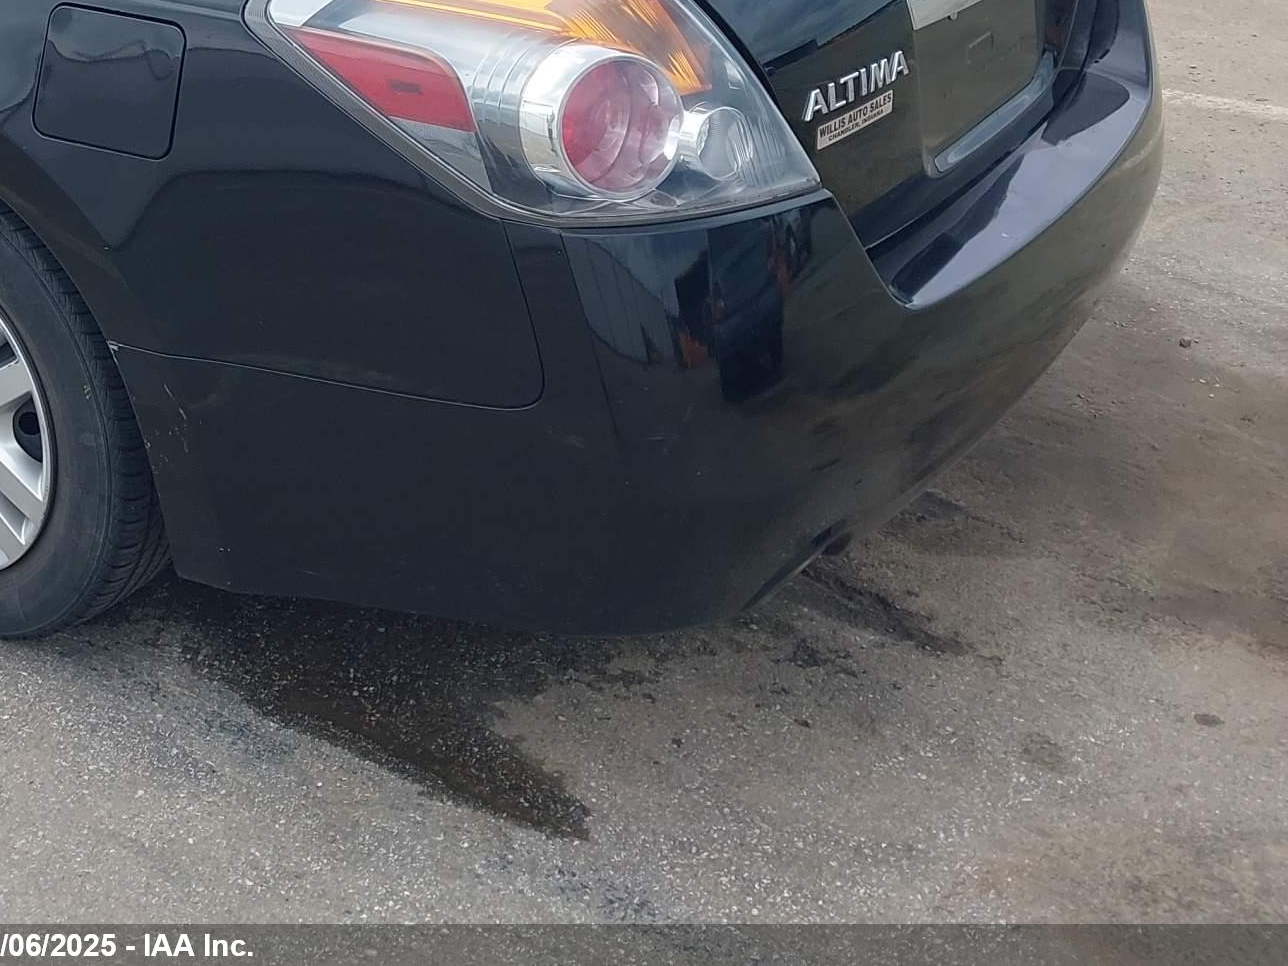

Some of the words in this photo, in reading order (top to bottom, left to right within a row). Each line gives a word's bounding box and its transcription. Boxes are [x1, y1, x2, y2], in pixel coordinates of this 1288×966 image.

[802, 50, 910, 122] ALTIMA
[819, 117, 846, 139] WILLIS
[847, 105, 869, 126] AUTO
[869, 93, 892, 113] SALES
